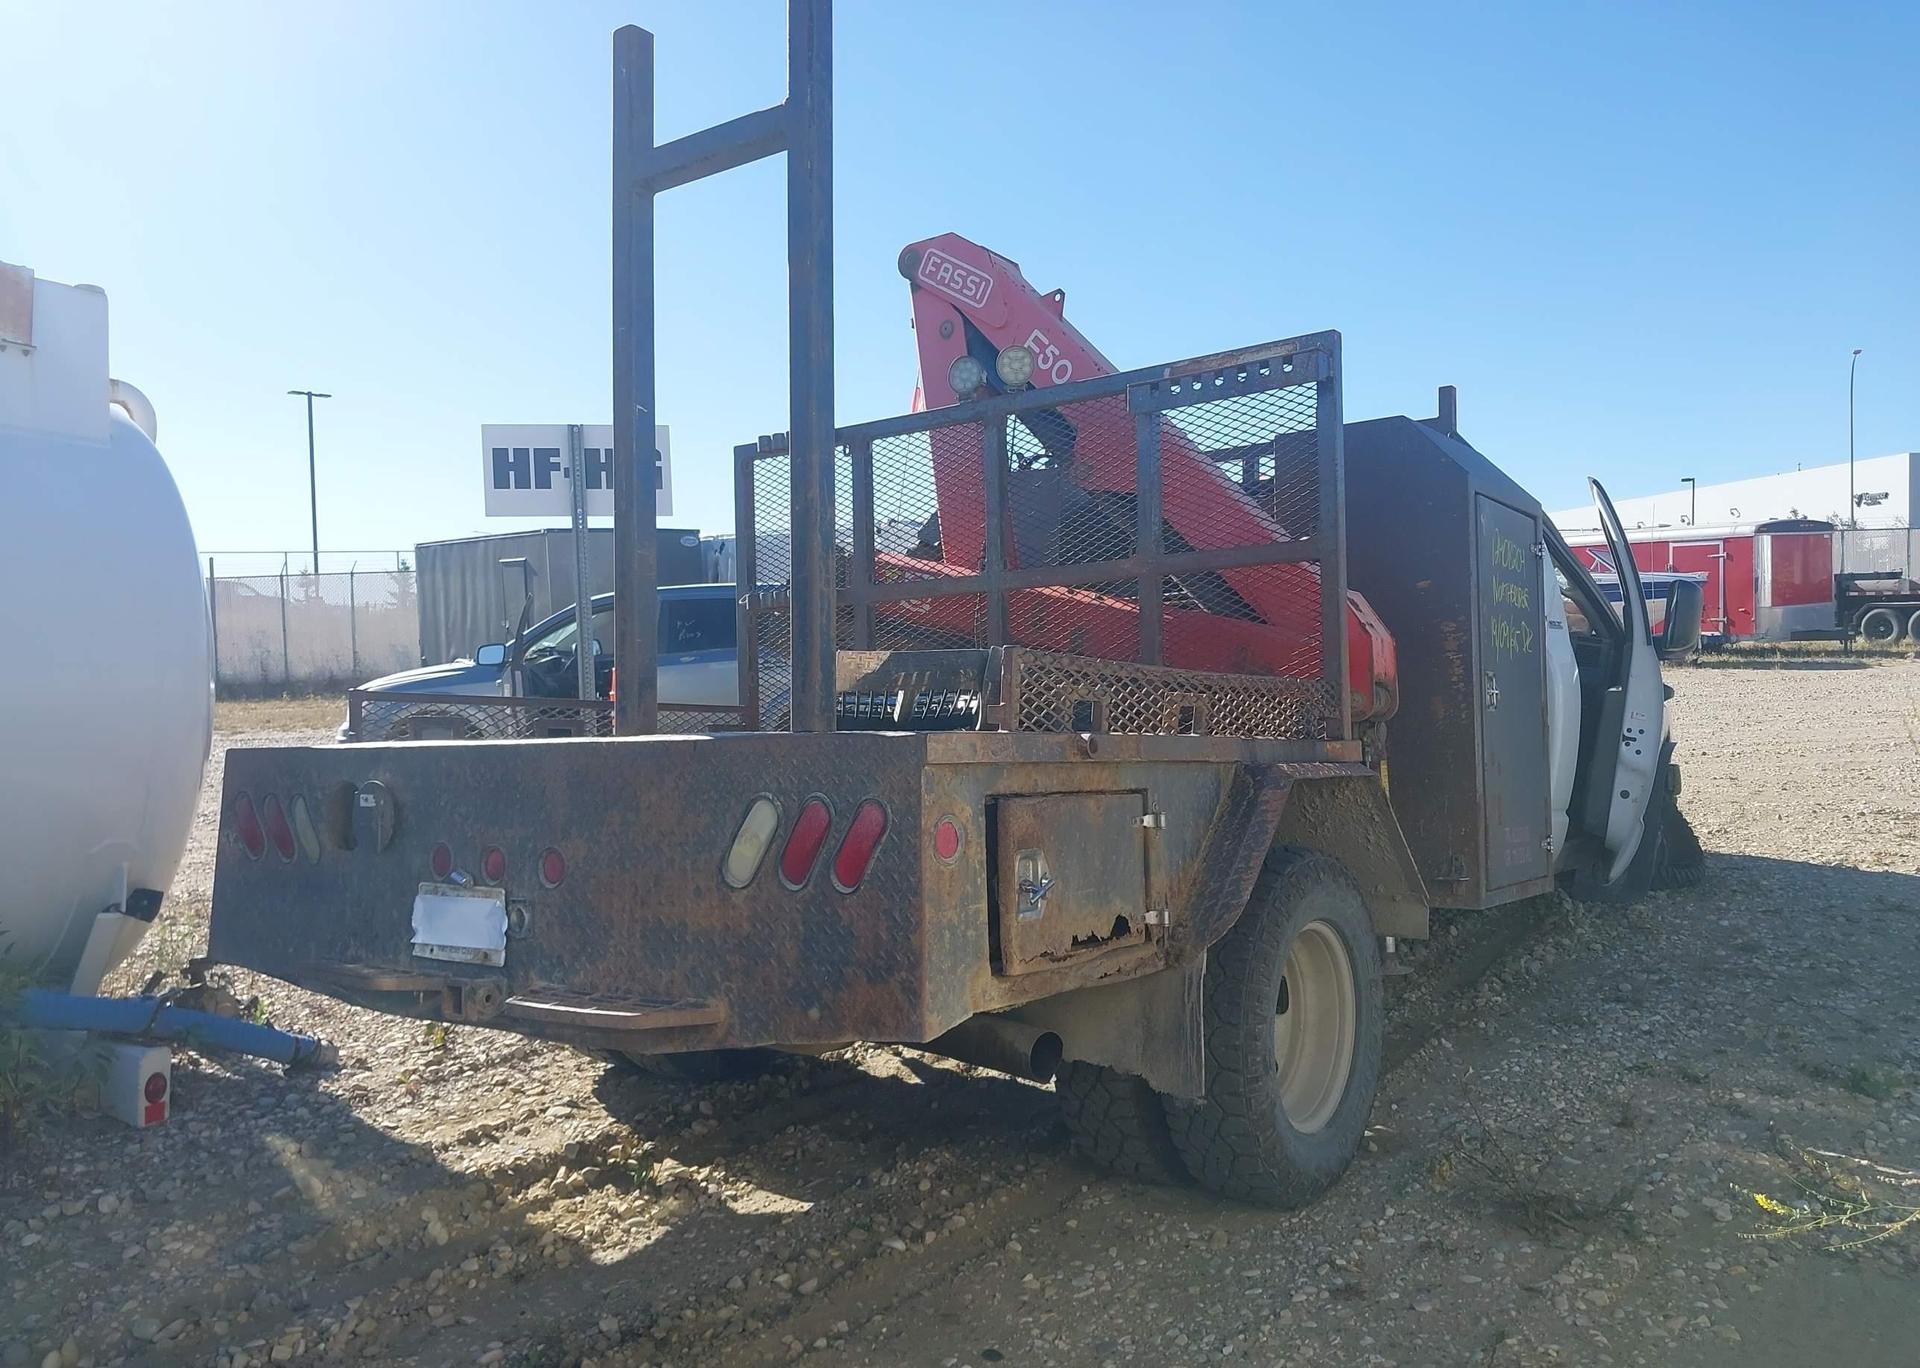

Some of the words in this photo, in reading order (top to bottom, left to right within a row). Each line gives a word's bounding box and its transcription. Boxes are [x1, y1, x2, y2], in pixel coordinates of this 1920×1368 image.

[925, 255, 986, 300] FASSI
[1024, 329, 1073, 385] F50
[492, 447, 663, 489] HF-H
